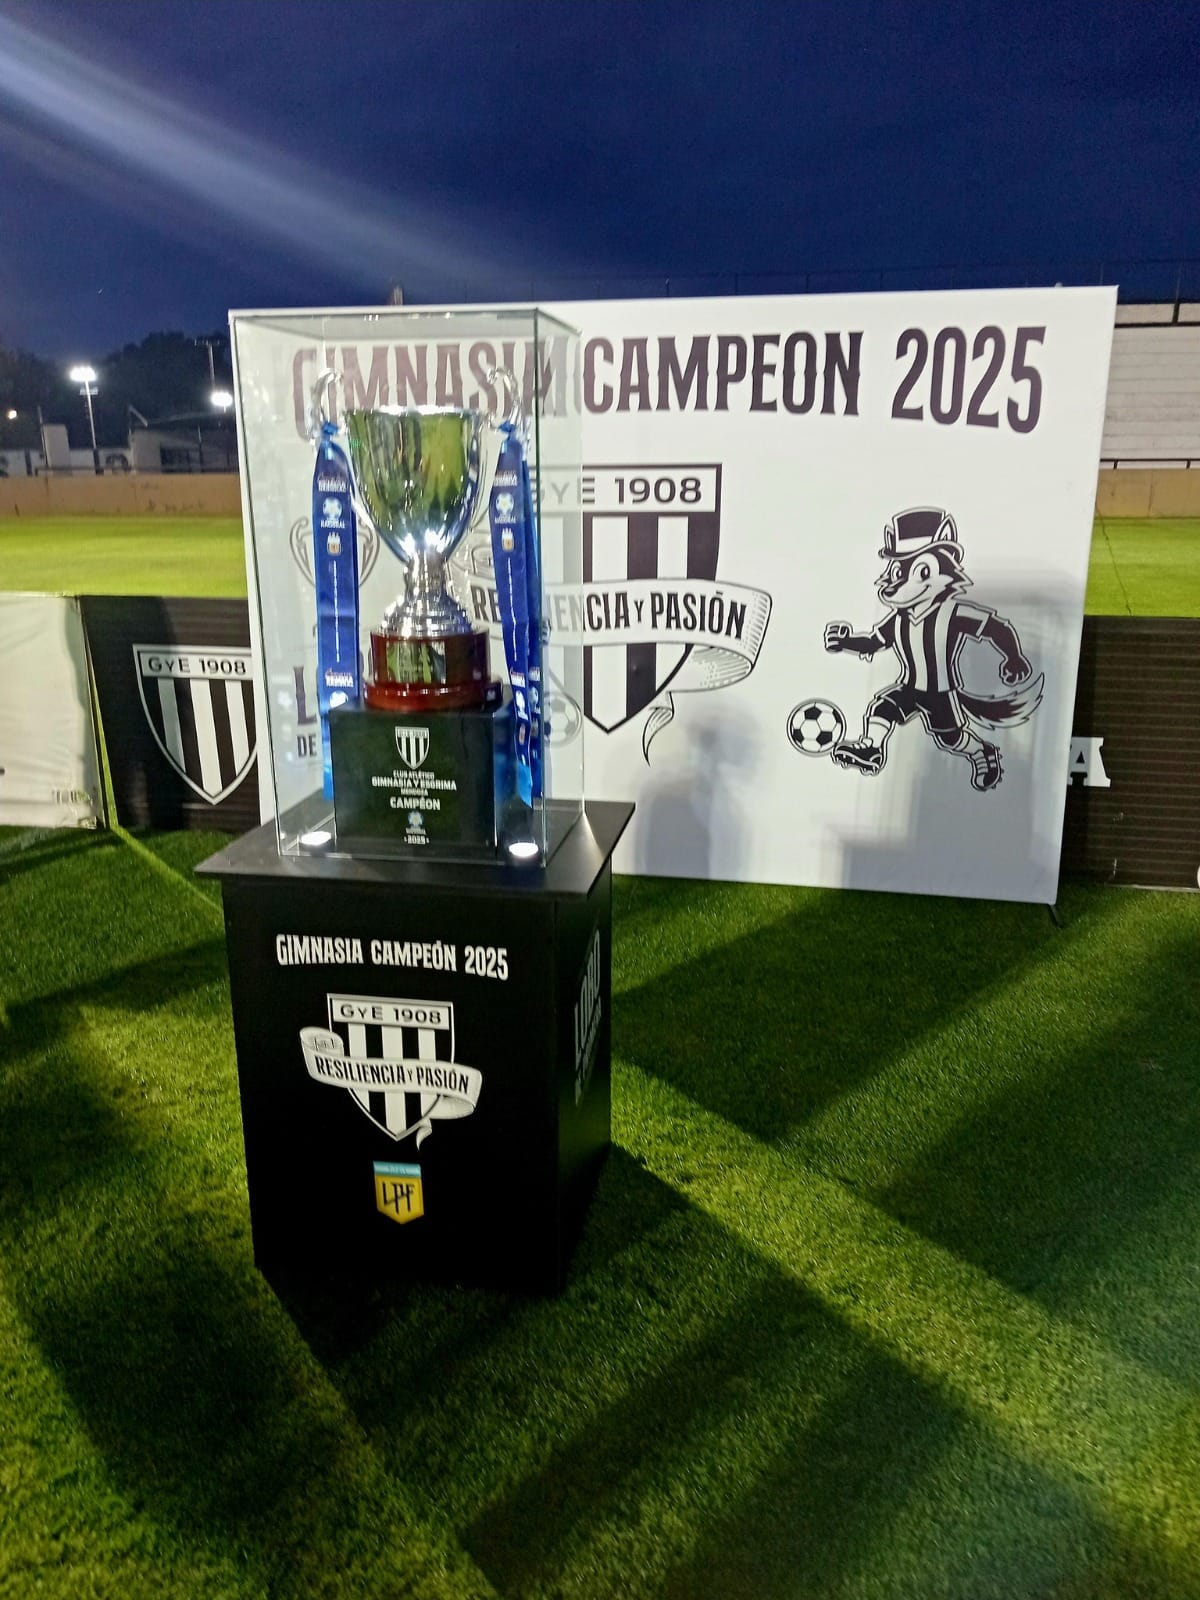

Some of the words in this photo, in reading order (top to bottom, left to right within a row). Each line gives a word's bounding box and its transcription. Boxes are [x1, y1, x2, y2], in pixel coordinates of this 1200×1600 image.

[583, 330, 864, 416] CAMPEON
[891, 326, 1047, 433] 2025
[614, 477, 703, 504] 1908
[650, 591, 747, 640] PASIÓN
[199, 658, 246, 675] 1908
[276, 933, 364, 966] GIMNASIA
[370, 939, 457, 972] CAMPEÓN
[464, 944, 509, 981] 2025
[394, 1007, 441, 1025] 1908
[314, 1055, 406, 1086] RESILIENCIA
[415, 1066, 469, 1095] PASIÓN
